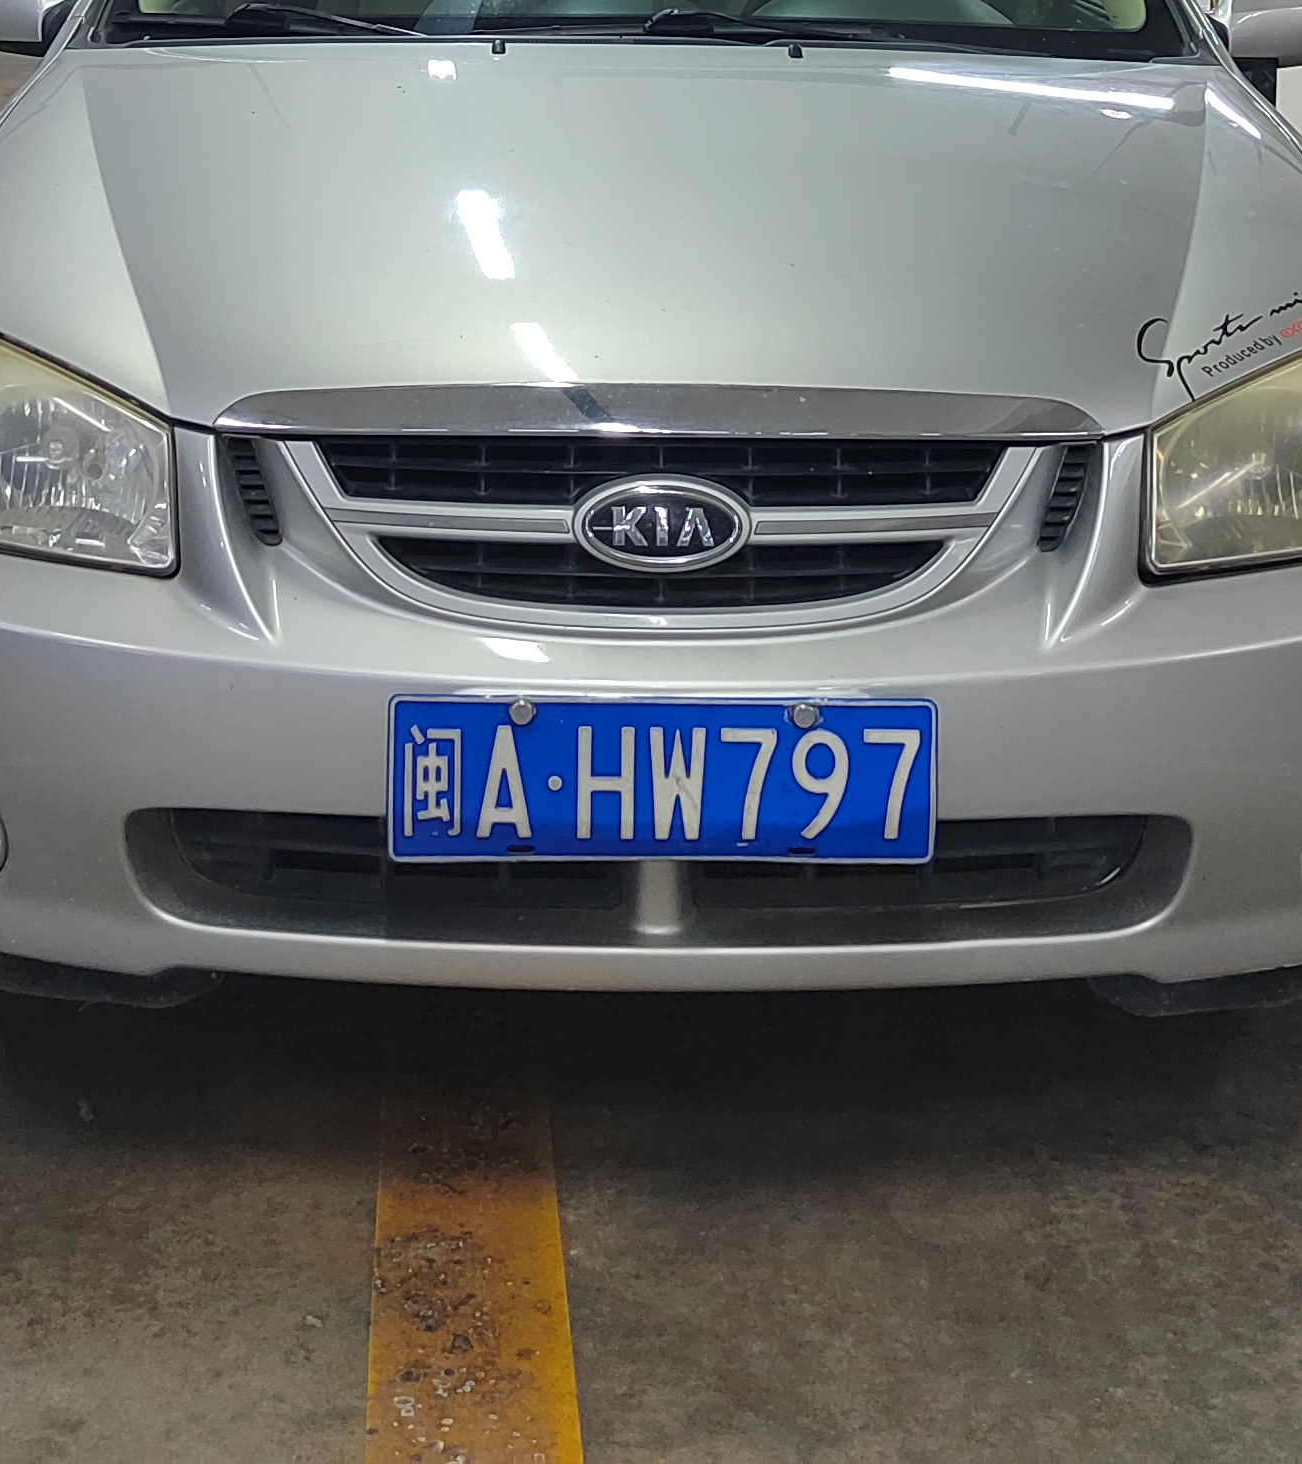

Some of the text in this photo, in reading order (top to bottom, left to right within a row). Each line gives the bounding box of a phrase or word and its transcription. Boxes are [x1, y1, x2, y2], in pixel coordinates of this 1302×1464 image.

[1201, 340, 1266, 378] Produced
[1264, 333, 1284, 350] by
[610, 504, 716, 548] KIA
